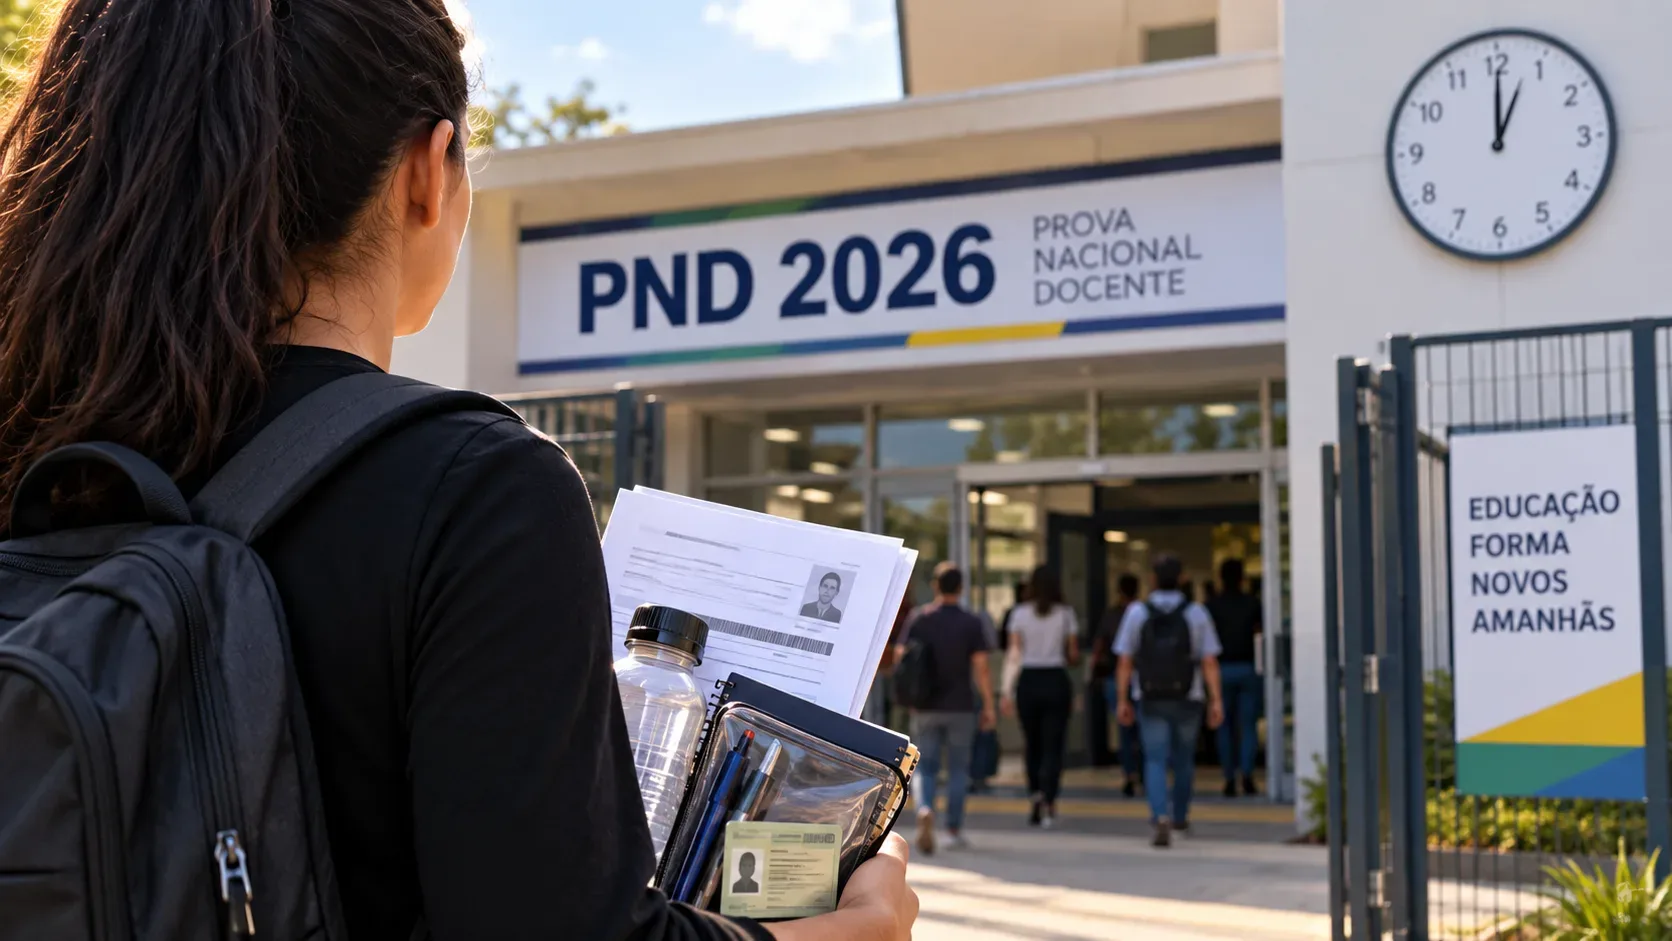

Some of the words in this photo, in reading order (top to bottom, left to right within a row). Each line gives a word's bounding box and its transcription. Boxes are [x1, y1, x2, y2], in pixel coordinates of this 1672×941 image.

[1485, 53, 1509, 76] 12
[1535, 59, 1543, 80] 1
[1448, 69, 1466, 90] 11
[1563, 85, 1578, 107] 2
[1420, 101, 1443, 123] 10
[1576, 125, 1591, 148] 3
[1409, 143, 1423, 165] 9
[1564, 169, 1579, 191] 4
[1422, 182, 1436, 204] 8
[1452, 208, 1466, 231] 7
[1535, 201, 1550, 224] 5
[1033, 208, 1136, 241] PROVA
[1493, 216, 1507, 238] 6
[1033, 234, 1202, 271] NACIONAL
[578, 249, 754, 333] PND
[778, 224, 997, 319] 2026
[1034, 268, 1186, 305] DOCENTE
[1469, 484, 1620, 523] EDUCAÇÃO
[1470, 530, 1570, 558] FORMA
[1471, 568, 1568, 595] NOVOS
[1472, 600, 1616, 633] AMANHÃS
